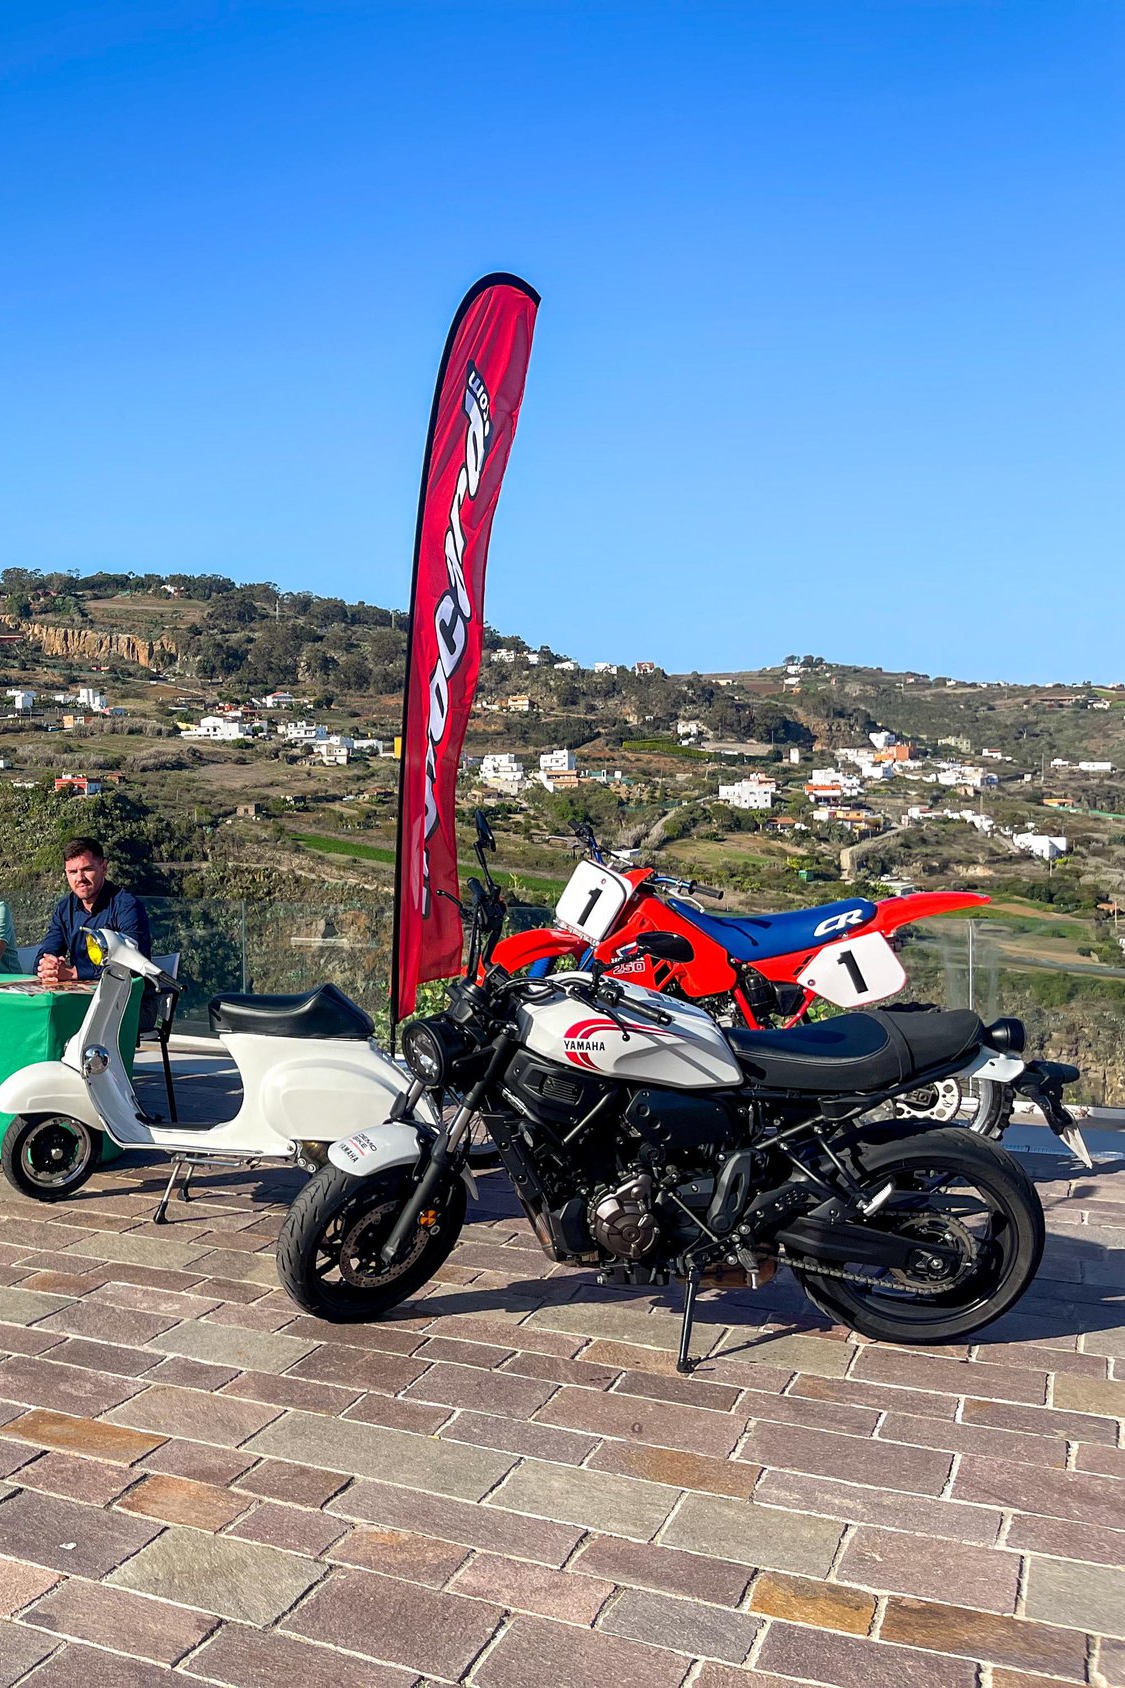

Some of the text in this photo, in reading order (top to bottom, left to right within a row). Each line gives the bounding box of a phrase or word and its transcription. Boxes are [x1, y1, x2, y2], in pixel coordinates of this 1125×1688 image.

[577, 887, 604, 926] 1
[813, 909, 863, 937] CR
[613, 961, 645, 975] 250
[836, 949, 869, 994] 1
[564, 1040, 606, 1051] YAMAHA
[357, 1133, 377, 1152] DEMO
[338, 1143, 359, 1163] YAMAHA
